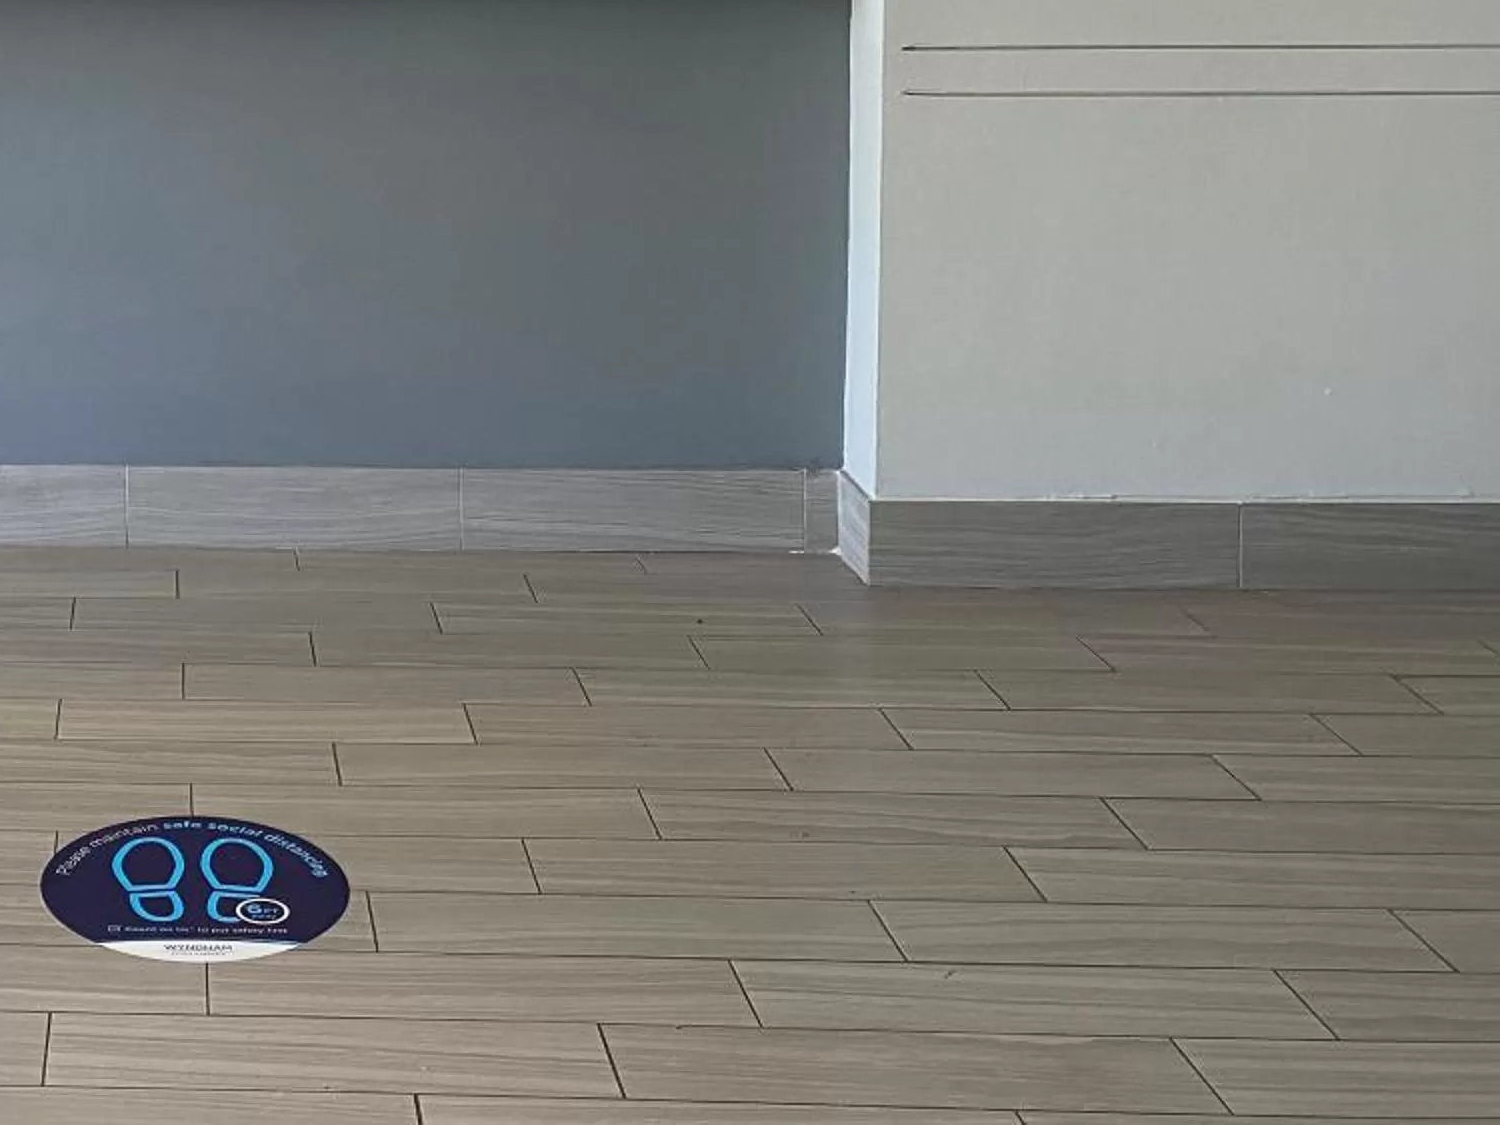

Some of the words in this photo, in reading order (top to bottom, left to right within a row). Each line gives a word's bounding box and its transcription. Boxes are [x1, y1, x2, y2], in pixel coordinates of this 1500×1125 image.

[56, 846, 91, 876] Please
[89, 823, 160, 848] maintain
[163, 820, 202, 830] safe
[207, 822, 263, 837] social
[263, 833, 329, 878] distancing
[163, 944, 233, 952] WYNDHAM
